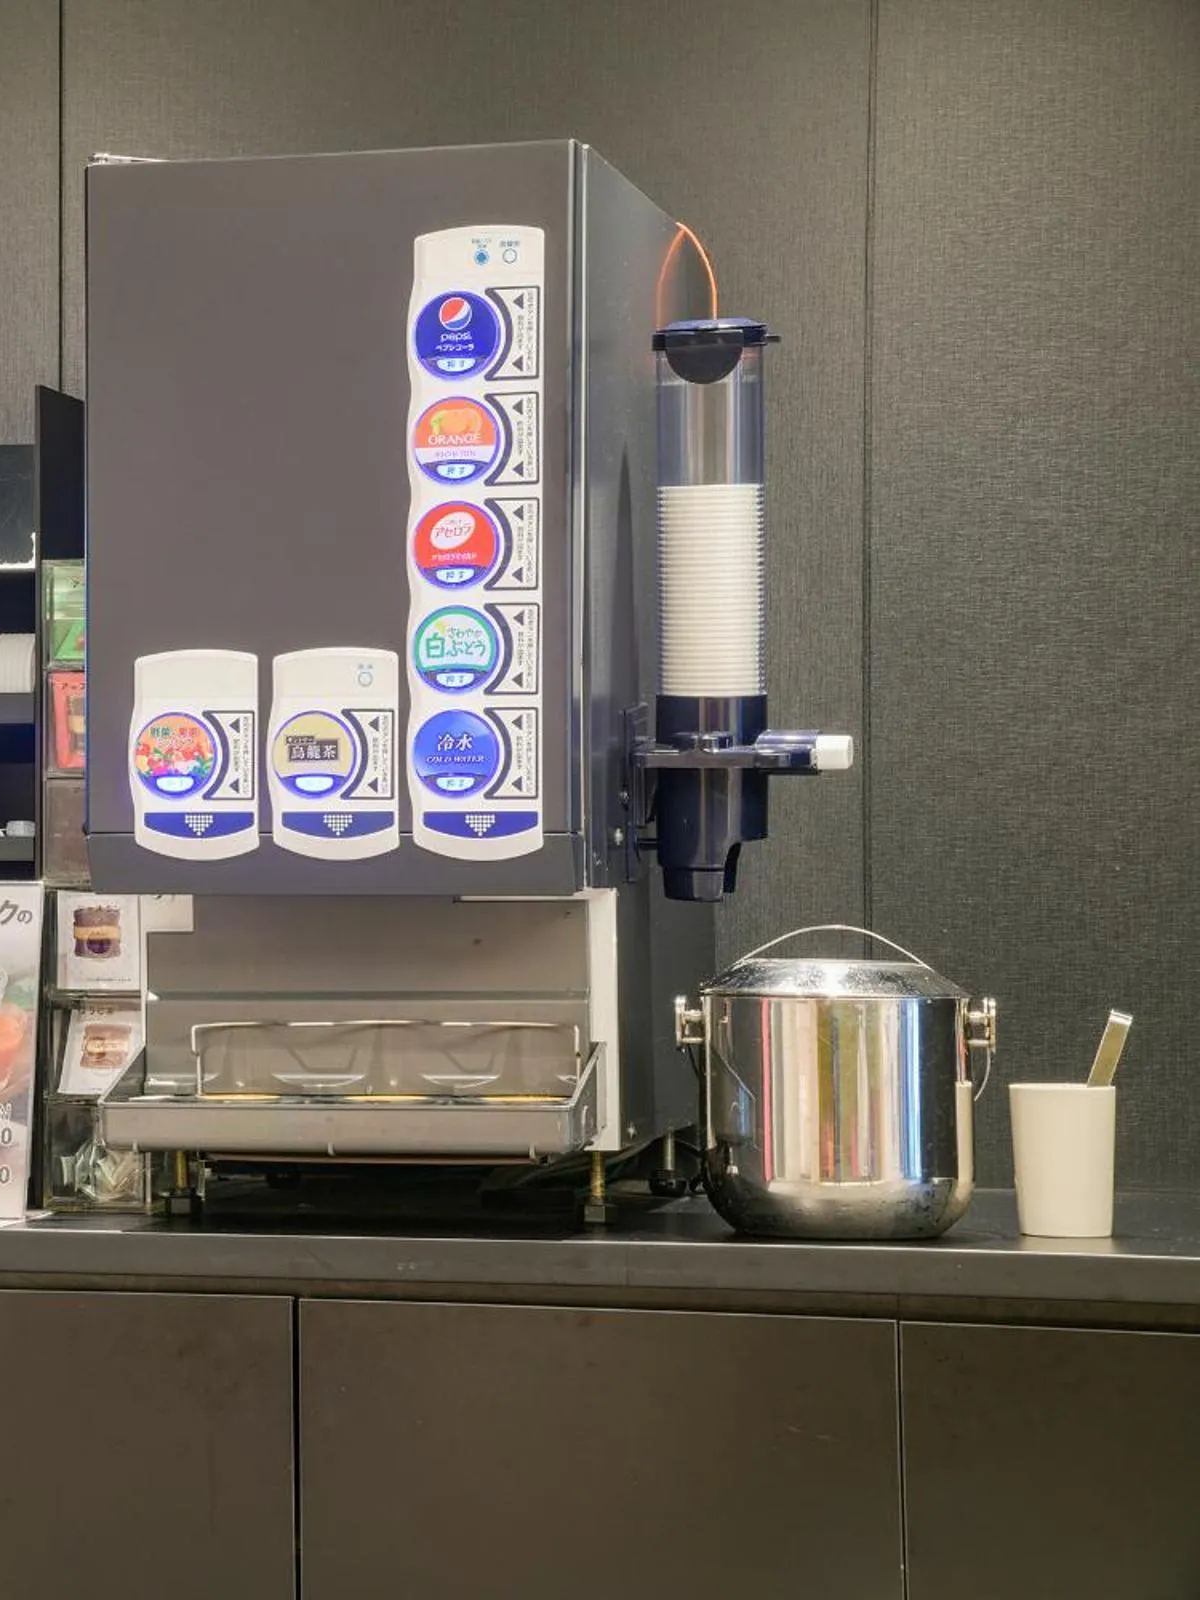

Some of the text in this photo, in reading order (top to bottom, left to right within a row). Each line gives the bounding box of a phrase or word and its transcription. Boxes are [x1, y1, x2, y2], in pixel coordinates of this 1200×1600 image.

[440, 332, 472, 343] pepsi
[427, 432, 483, 446] ORANGE
[425, 633, 487, 658] 白ぶどう
[437, 733, 473, 752] 冷水
[426, 754, 486, 763] COLD WATER
